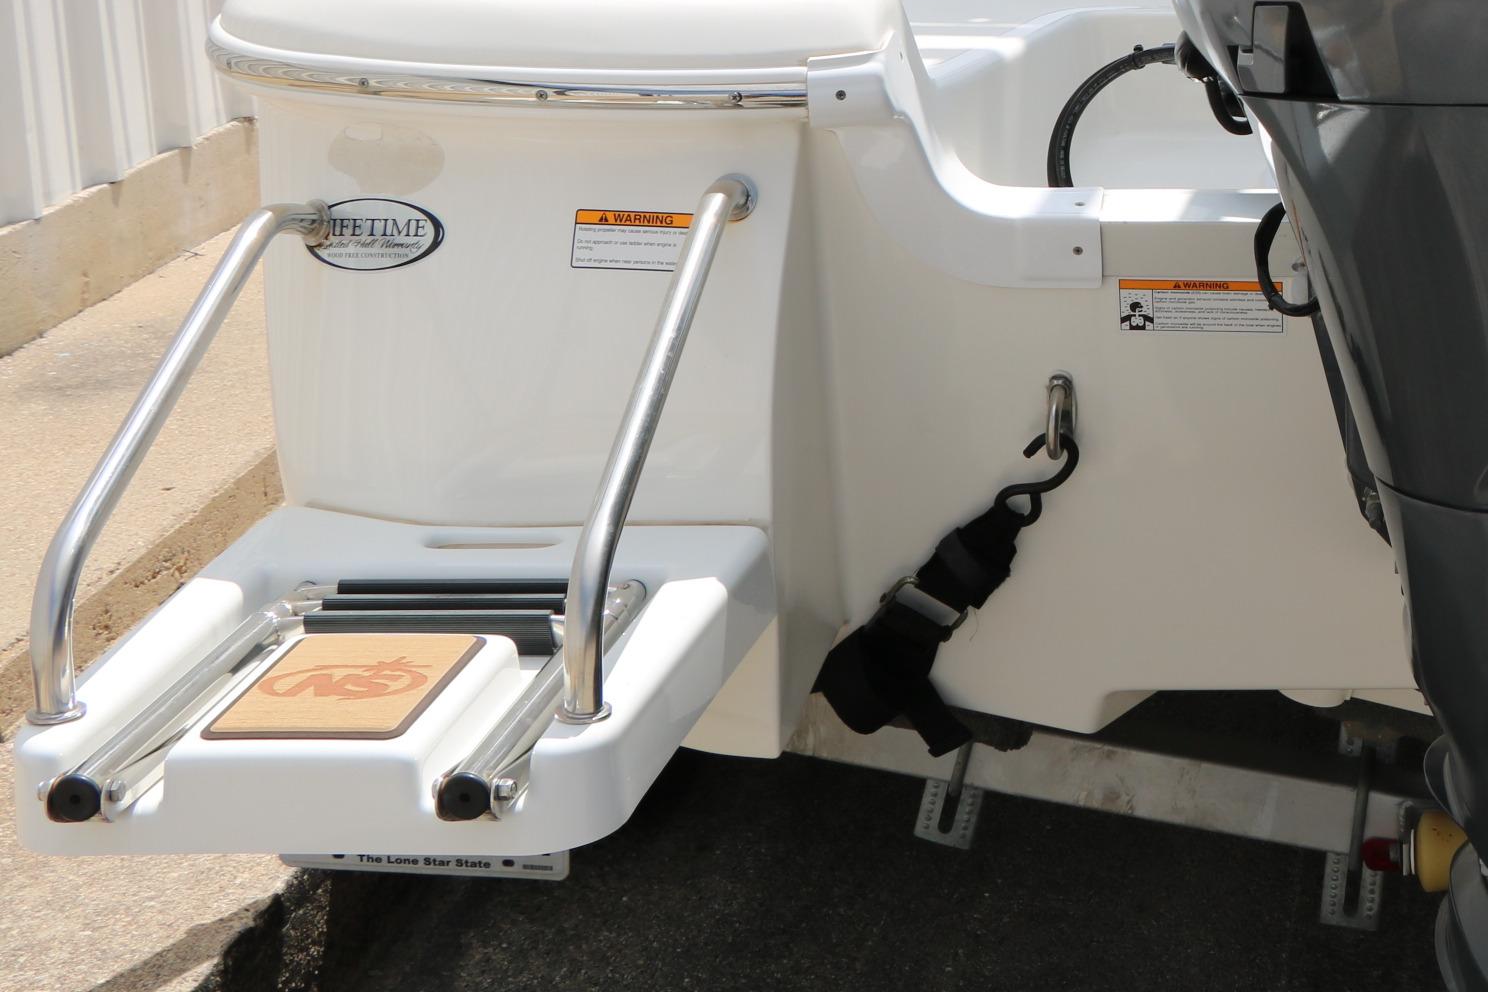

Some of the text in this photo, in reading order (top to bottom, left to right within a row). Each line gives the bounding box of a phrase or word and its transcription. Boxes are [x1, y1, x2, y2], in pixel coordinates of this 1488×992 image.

[613, 213, 674, 225] WARNING
[329, 218, 428, 237] IFETIME
[1183, 281, 1230, 289] WARNING
[357, 854, 491, 869] The Lone Star State
